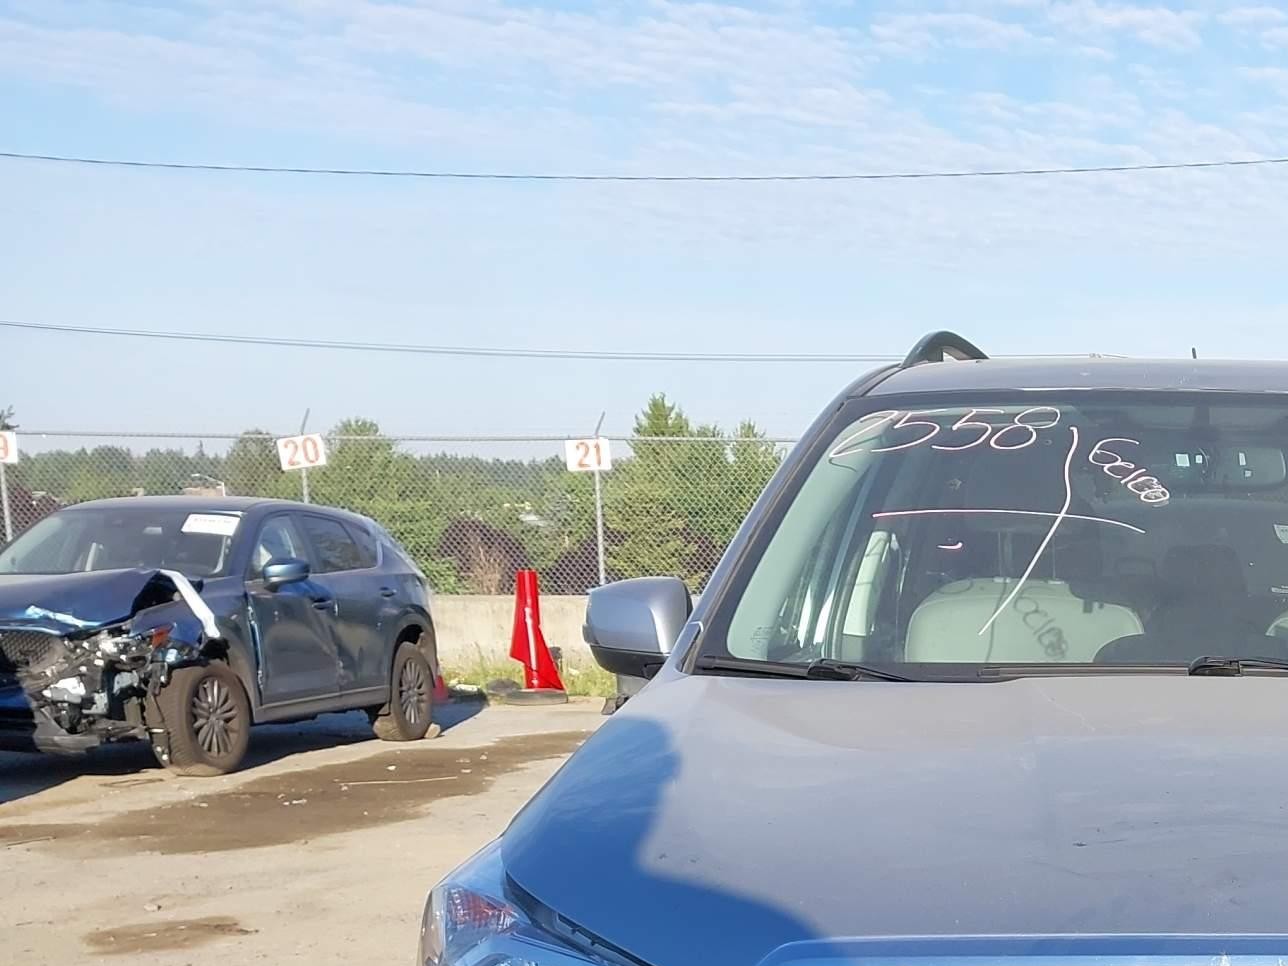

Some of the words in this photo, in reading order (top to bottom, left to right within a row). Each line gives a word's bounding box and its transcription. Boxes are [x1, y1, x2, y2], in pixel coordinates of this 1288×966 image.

[829, 406, 1060, 457] 2558
[283, 436, 320, 467] 20
[575, 441, 602, 468] 21
